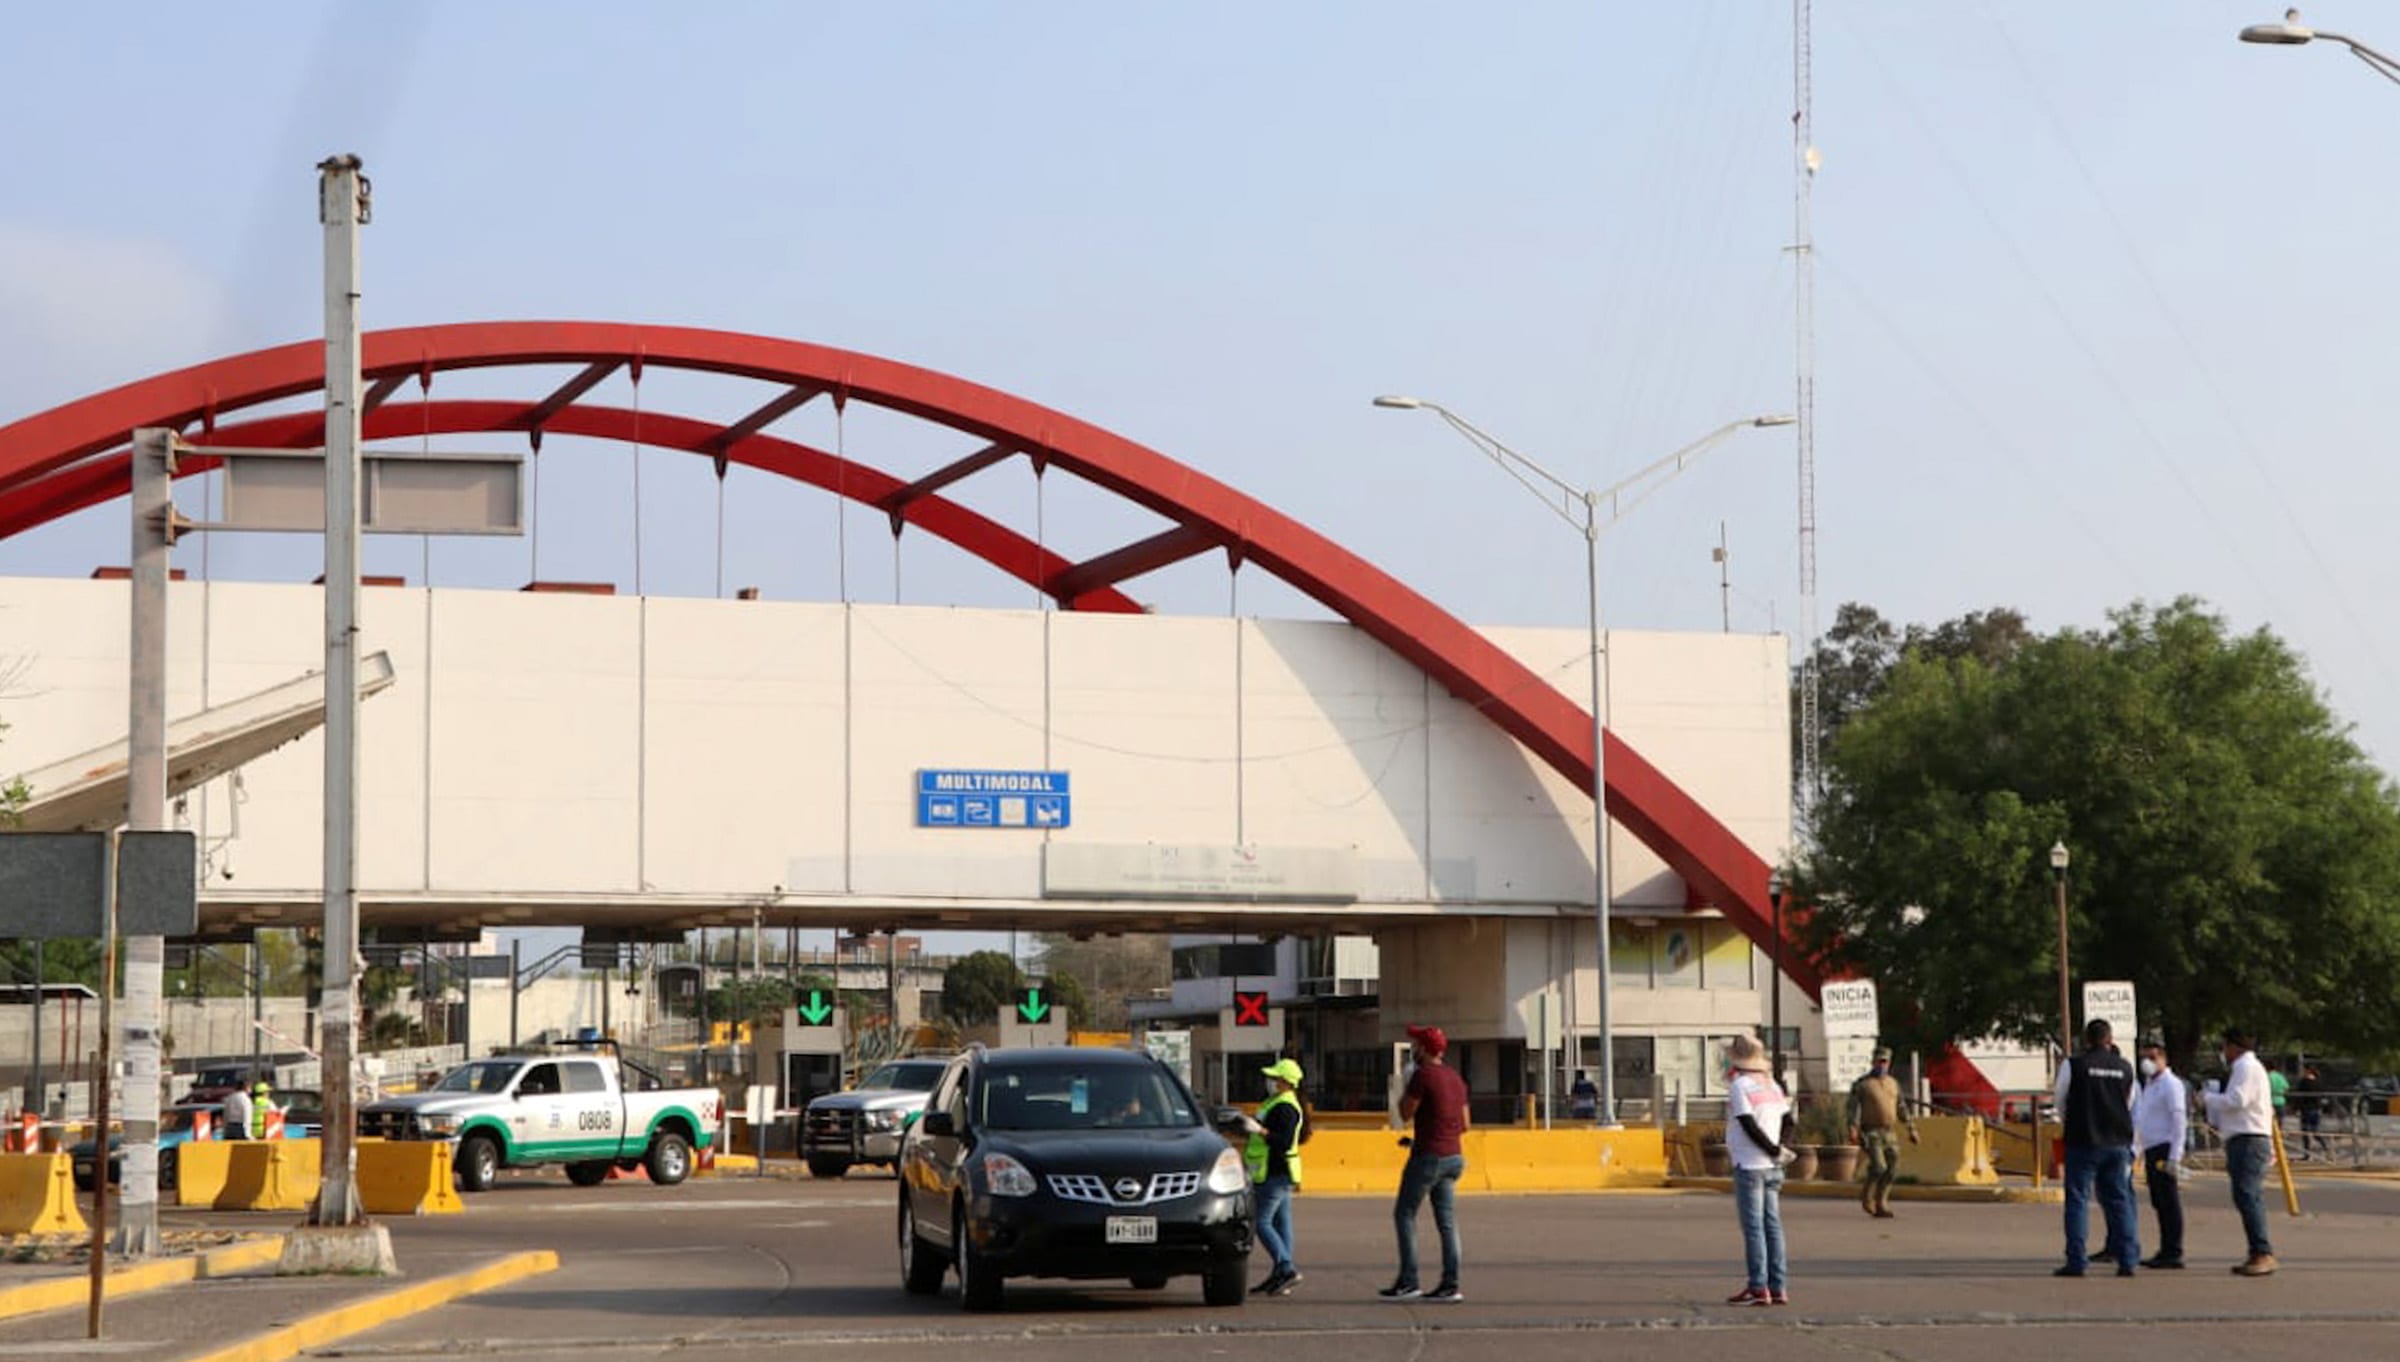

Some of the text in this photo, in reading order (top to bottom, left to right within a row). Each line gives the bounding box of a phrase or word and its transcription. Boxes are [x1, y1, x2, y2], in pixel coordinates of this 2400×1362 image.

[936, 773, 1054, 791] MULTIMODAL
[1826, 986, 1872, 1002] INICIA
[2087, 989, 2131, 1002] INICIA
[579, 1110, 612, 1131] 0808
